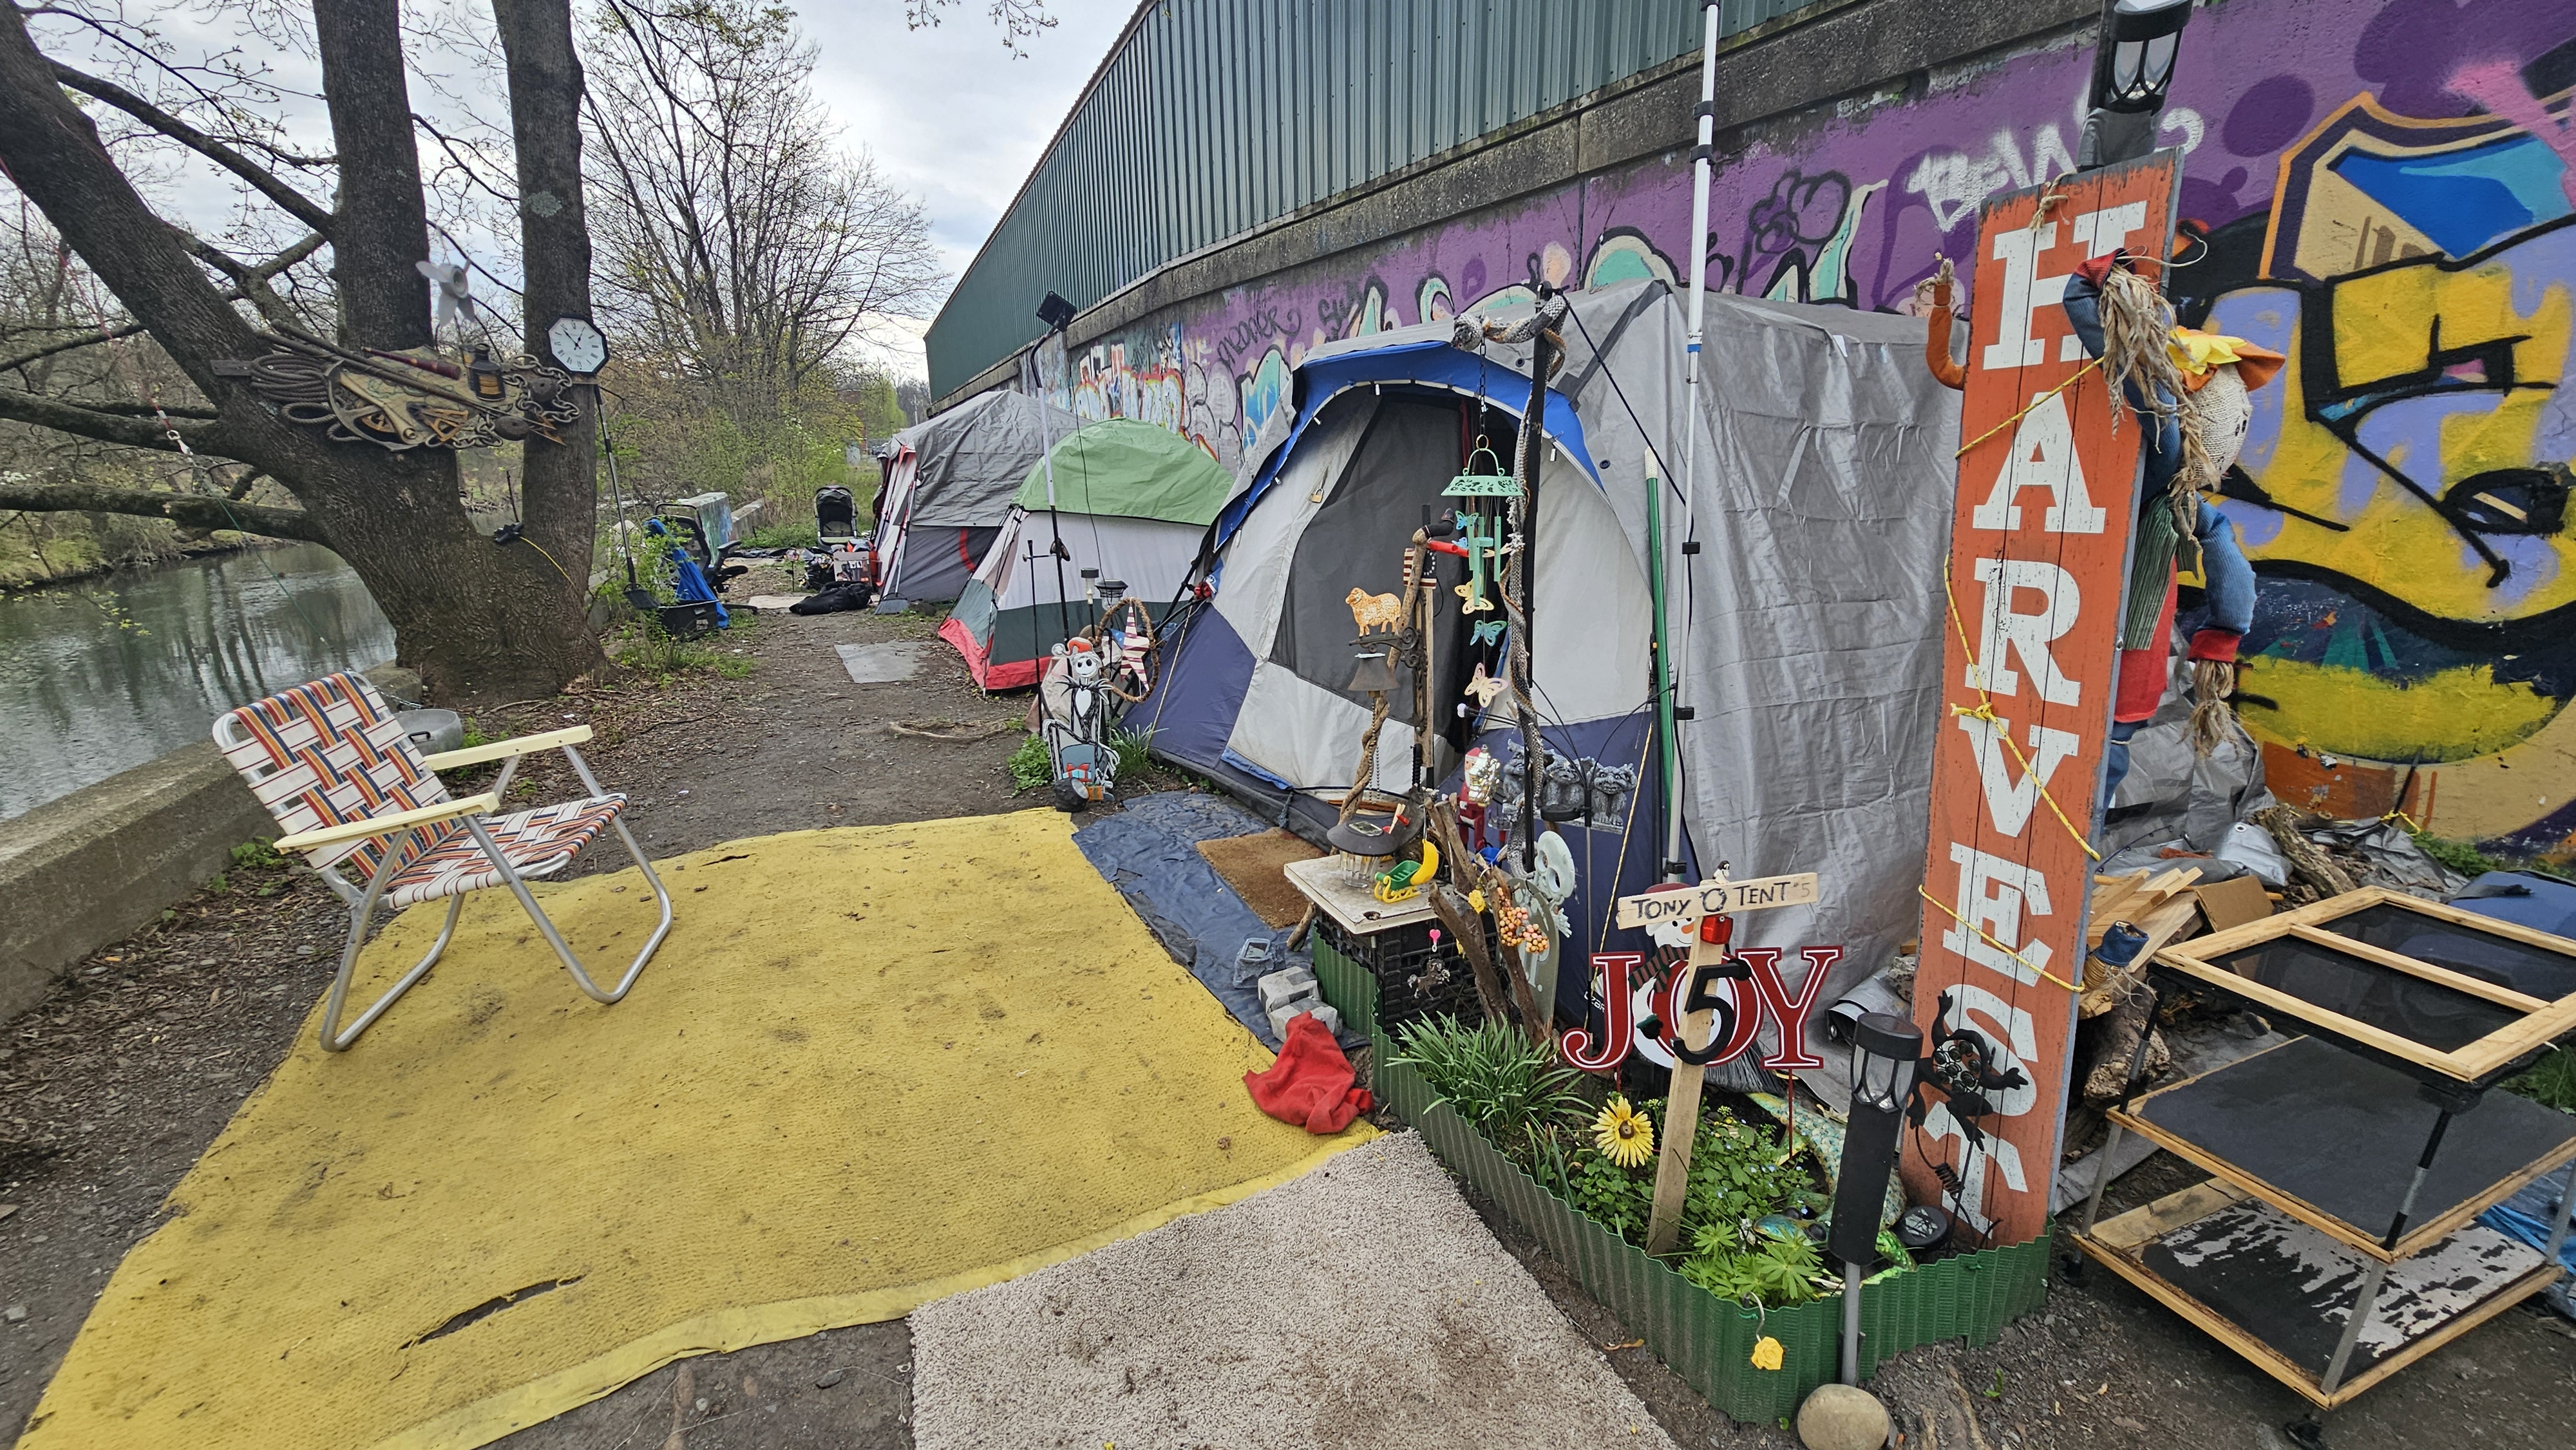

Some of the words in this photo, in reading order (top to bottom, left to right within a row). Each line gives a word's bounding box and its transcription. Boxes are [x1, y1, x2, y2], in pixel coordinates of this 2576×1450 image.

[1920, 200, 2148, 1241] HARVEST
[1631, 898, 1692, 921] TONY
[1733, 881, 1791, 906] TENT
[1560, 945, 1844, 1071] JOY
[1669, 964, 1737, 1066] 5
